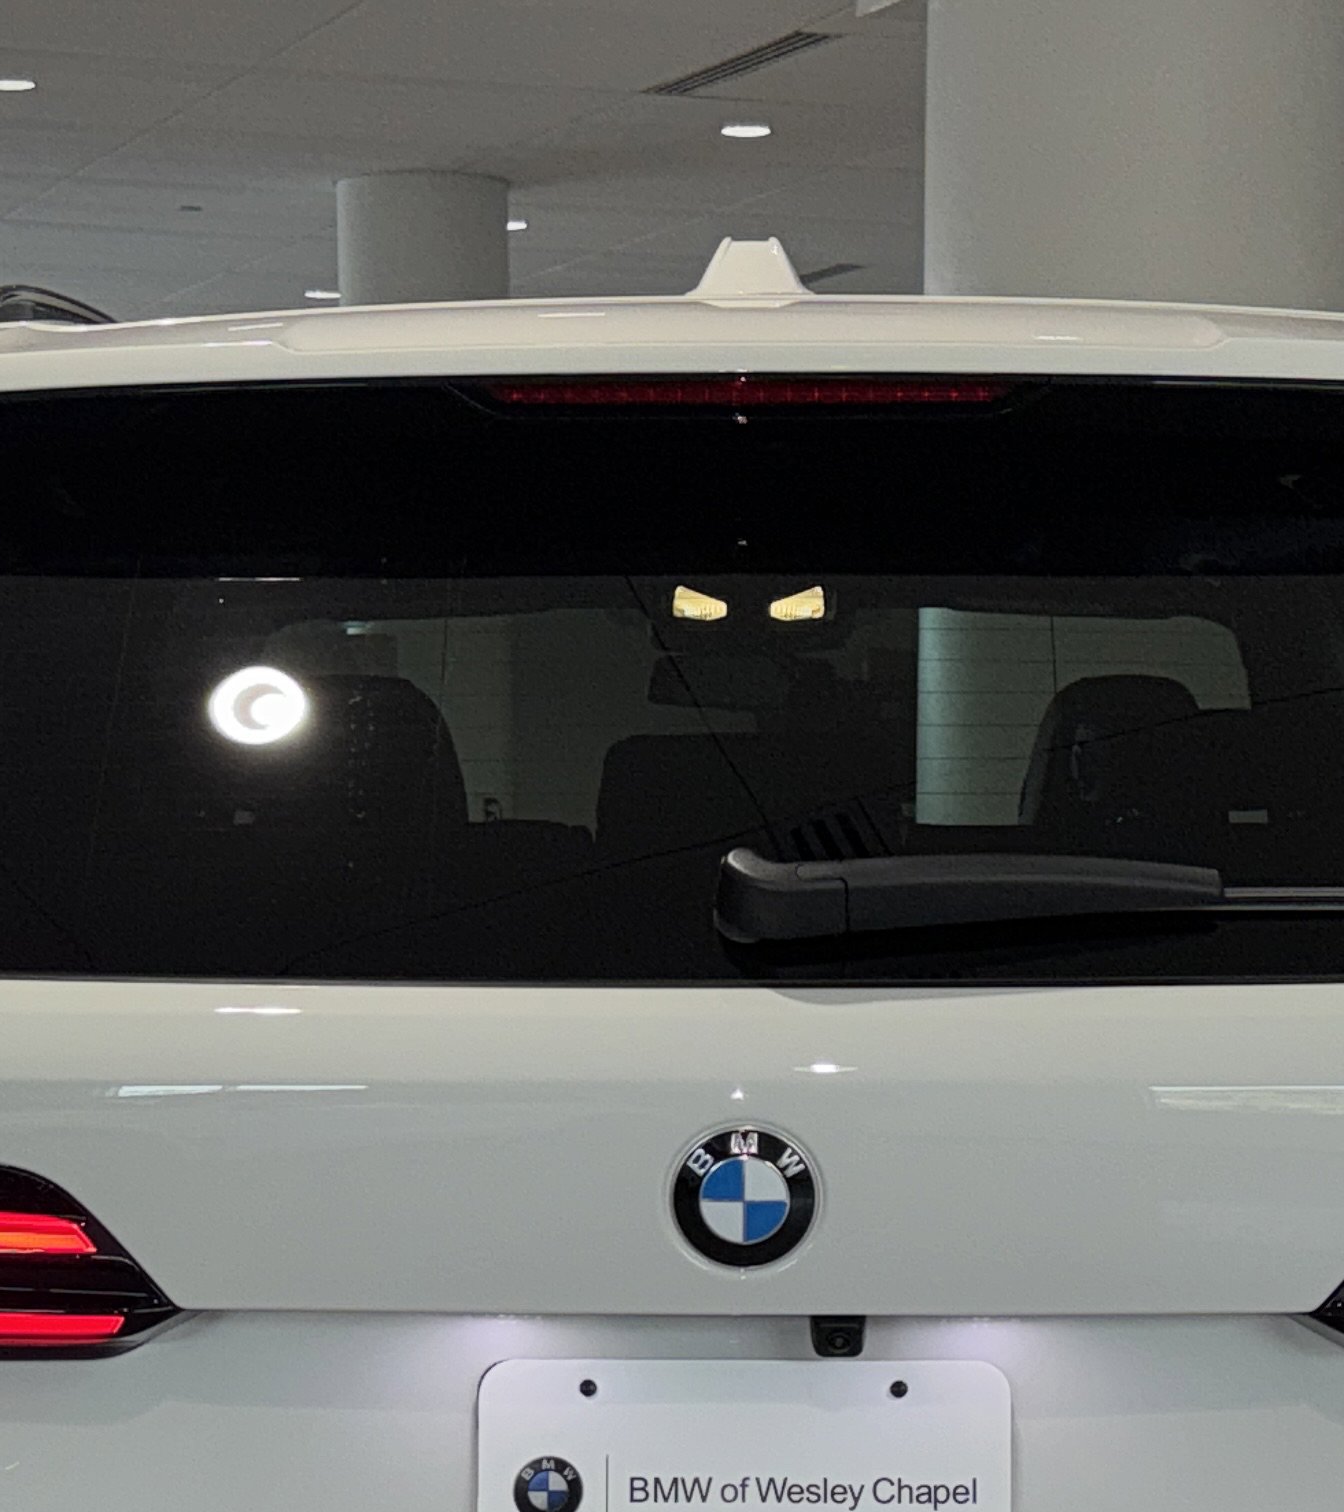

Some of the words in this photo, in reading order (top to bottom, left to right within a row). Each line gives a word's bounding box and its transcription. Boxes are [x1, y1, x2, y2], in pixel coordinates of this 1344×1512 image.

[687, 1132, 806, 1178] BMW
[521, 1459, 577, 1480] BMW
[630, 1477, 712, 1503] BMW
[720, 1477, 750, 1503] of
[755, 1477, 864, 1511] Wesley
[871, 1477, 977, 1511] Chapel
